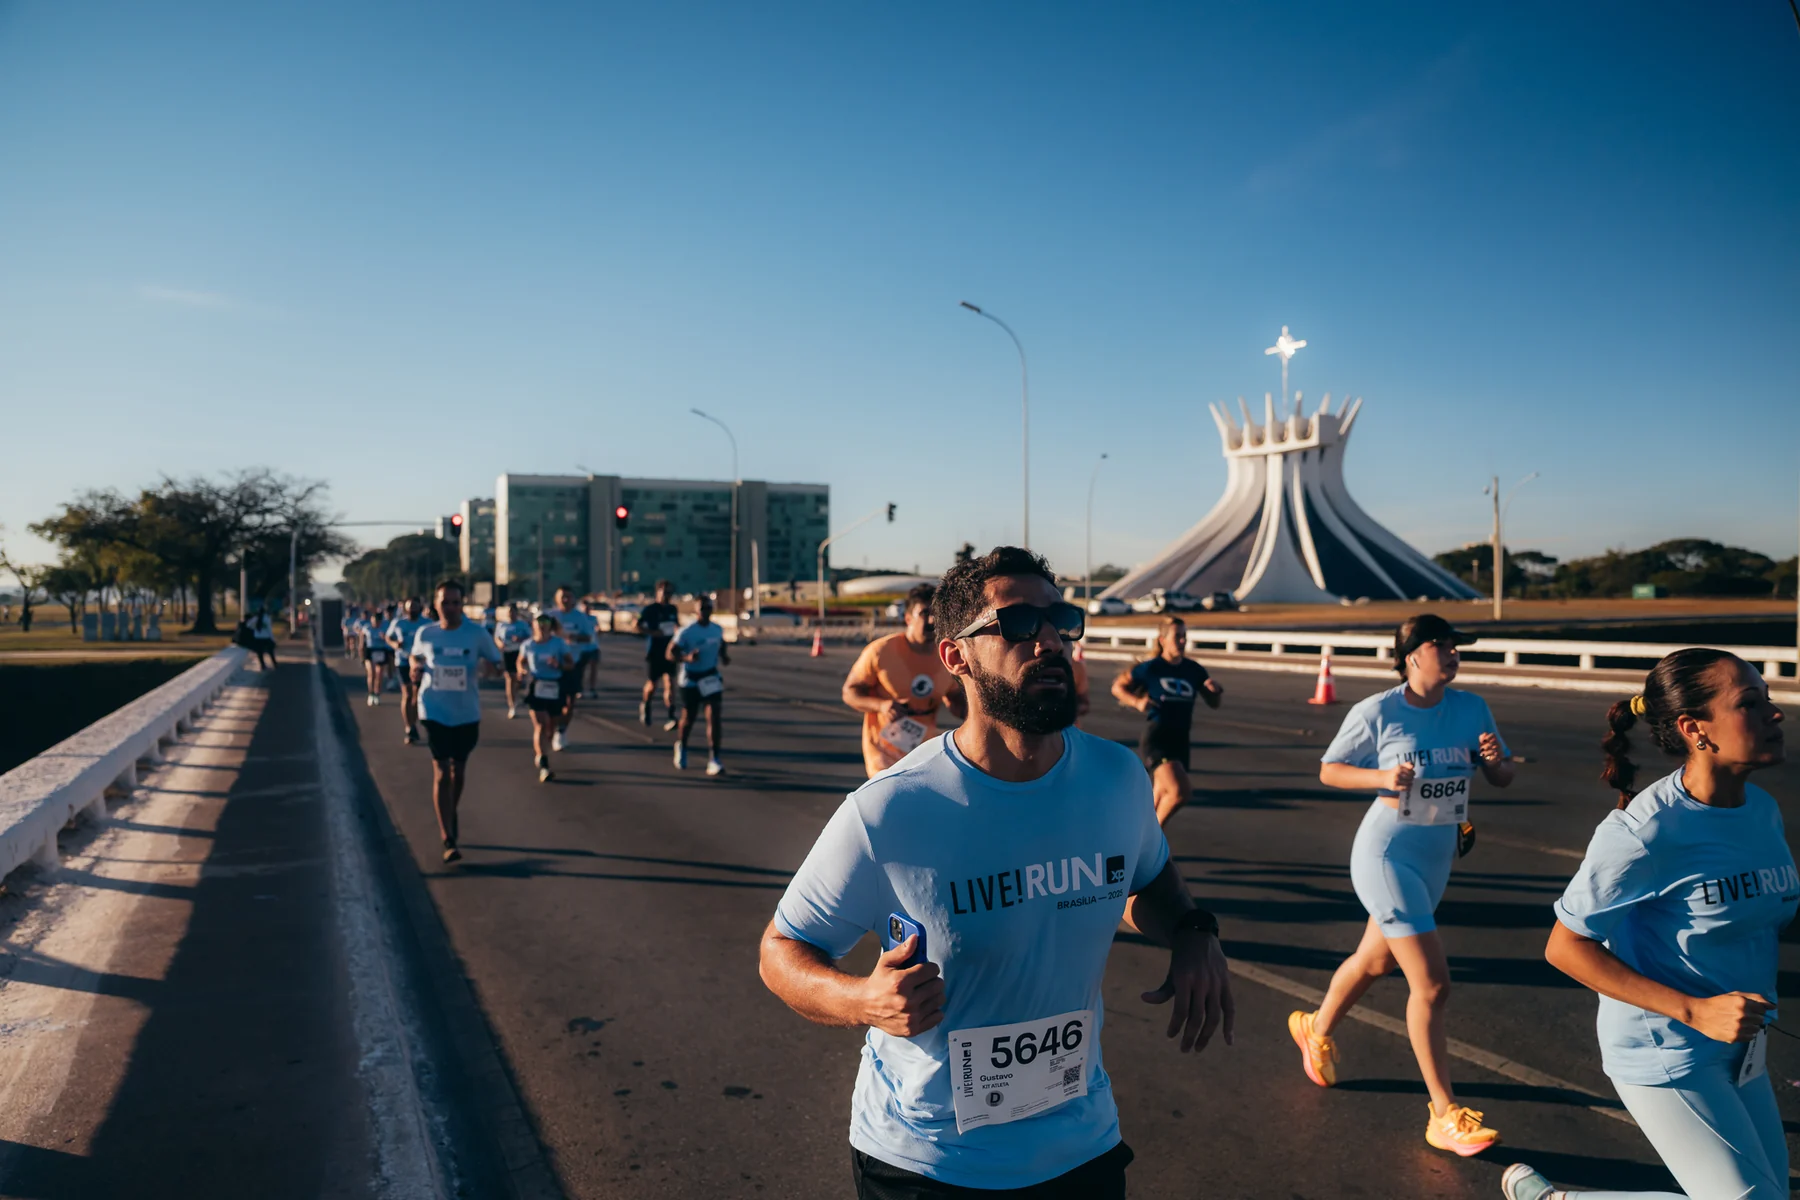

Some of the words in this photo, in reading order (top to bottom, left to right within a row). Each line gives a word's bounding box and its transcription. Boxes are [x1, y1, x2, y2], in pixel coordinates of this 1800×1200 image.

[1420, 779, 1466, 799] 6864
[1057, 894, 1097, 909] BRASÍLIA
[1108, 889, 1124, 900] 2025
[990, 1020, 1083, 1069] 5646
[979, 1073, 1014, 1082] Gustavo
[990, 1092, 1001, 1104] D
